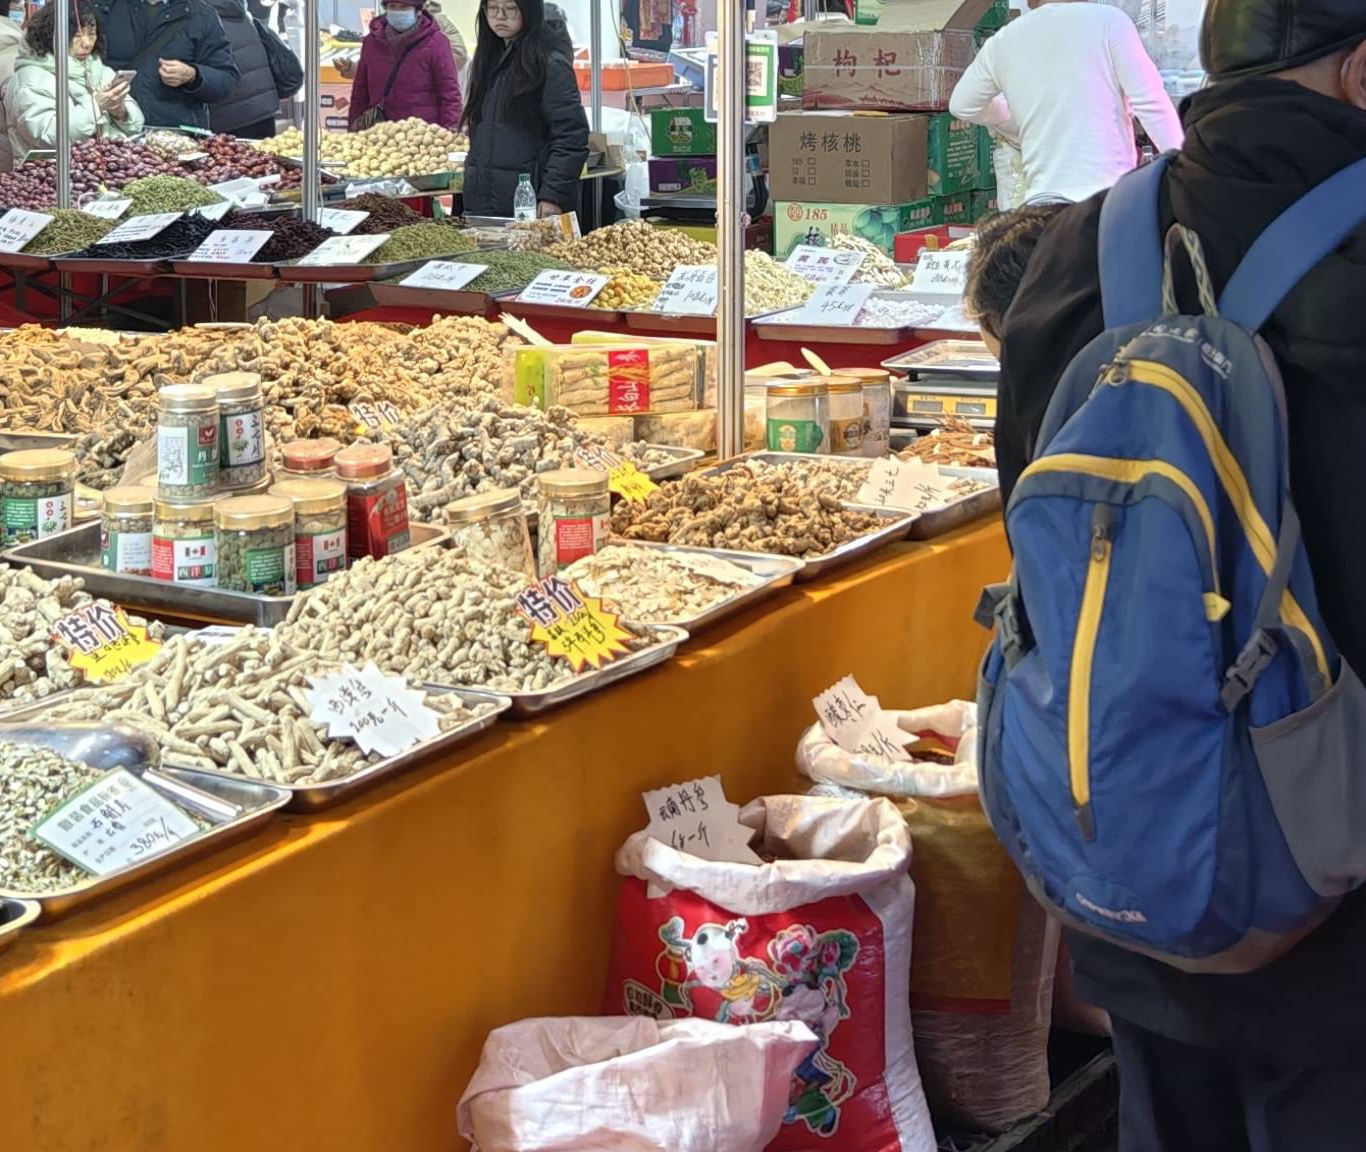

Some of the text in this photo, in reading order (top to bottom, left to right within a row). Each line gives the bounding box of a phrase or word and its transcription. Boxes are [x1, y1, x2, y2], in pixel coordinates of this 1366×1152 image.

[832, 48, 902, 78] 枸杞
[799, 131, 862, 153] 烤核桃
[804, 209, 828, 221] 185
[517, 577, 582, 626] 特价
[57, 605, 127, 653] 特价
